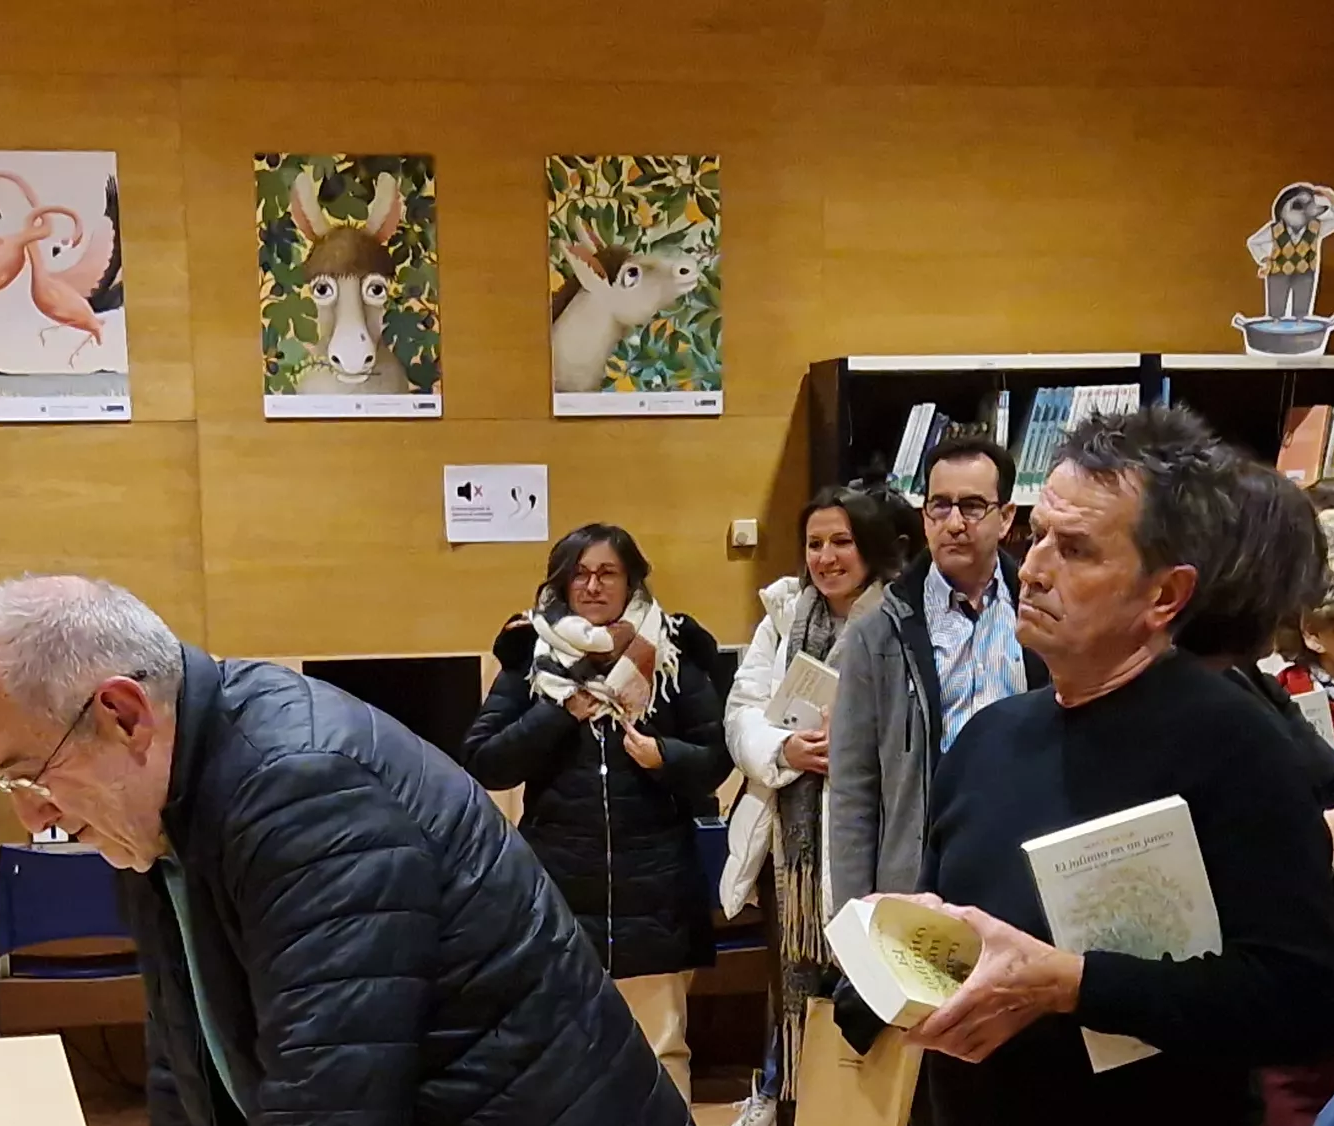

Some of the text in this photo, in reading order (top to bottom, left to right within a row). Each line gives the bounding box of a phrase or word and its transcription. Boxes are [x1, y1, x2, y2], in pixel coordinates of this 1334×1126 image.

[1054, 862, 1067, 874] El
[1068, 850, 1109, 871] infinito
[1111, 845, 1125, 856] en
[1127, 840, 1142, 852] un
[1143, 830, 1175, 848] junco
